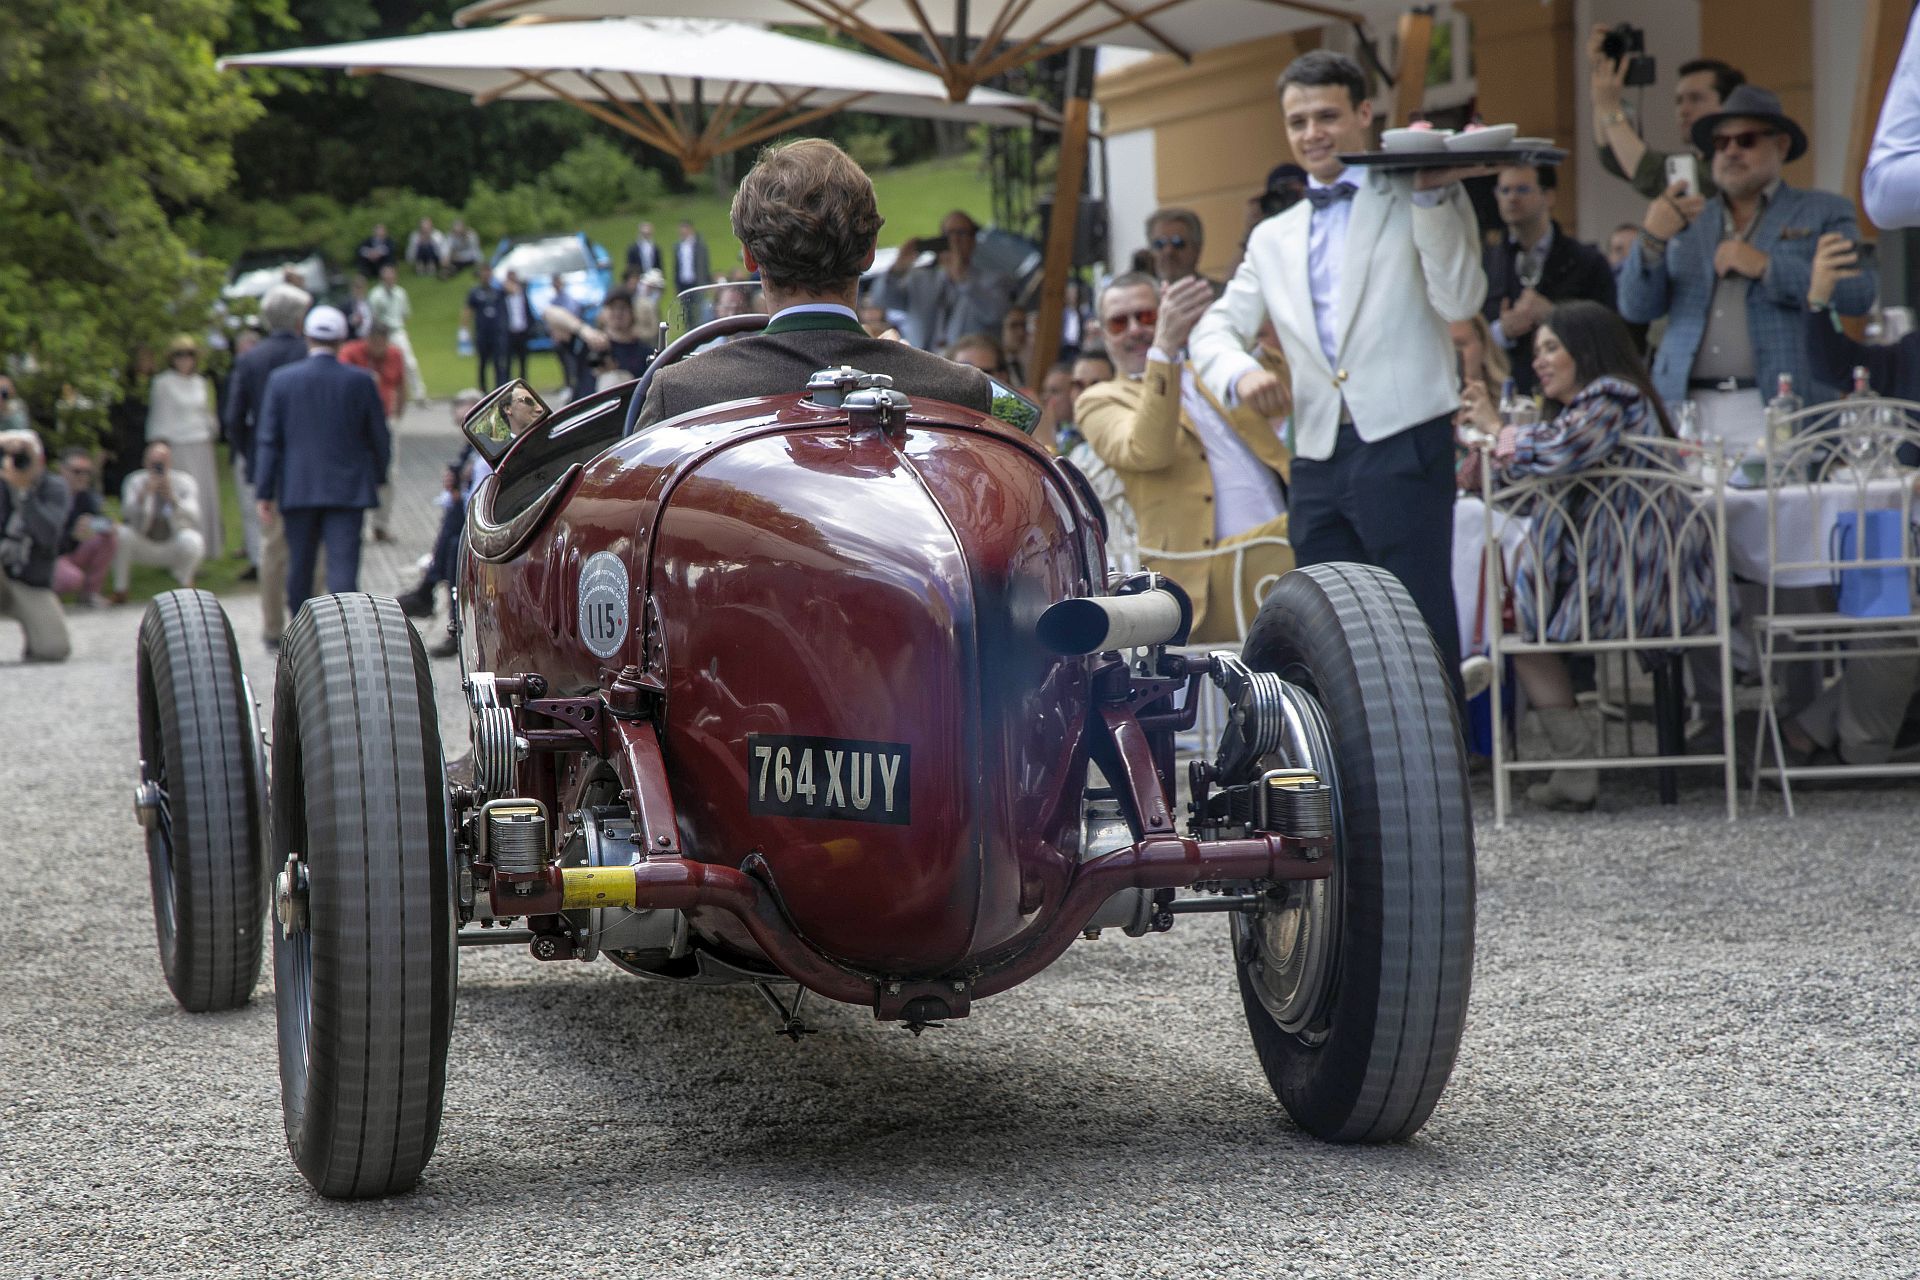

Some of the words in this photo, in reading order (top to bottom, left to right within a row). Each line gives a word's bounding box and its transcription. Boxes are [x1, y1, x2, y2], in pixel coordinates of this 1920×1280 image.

[588, 603, 615, 639] 115
[755, 746, 817, 806] 764
[824, 749, 901, 812] XUY
